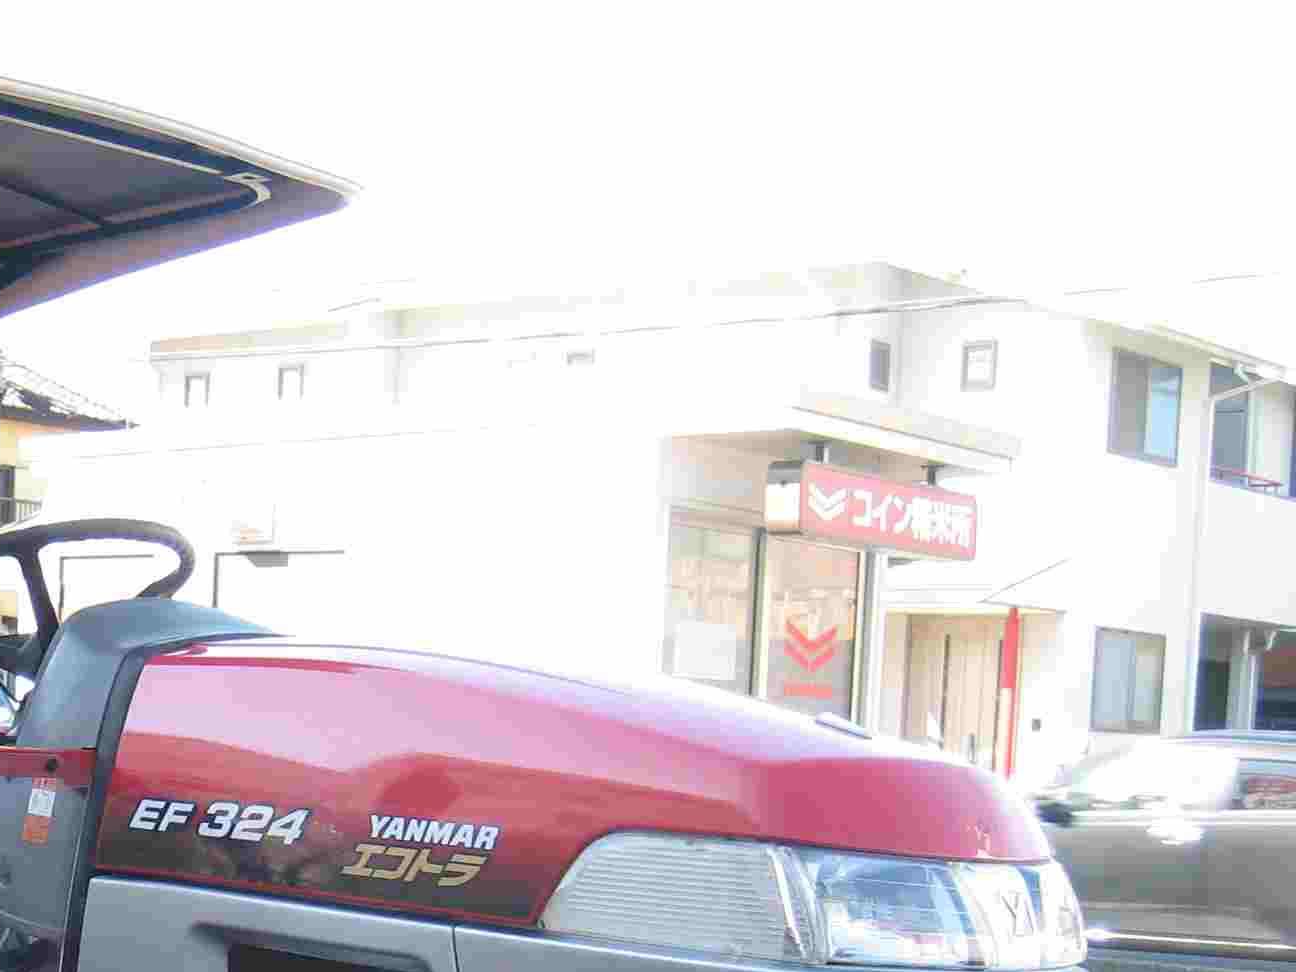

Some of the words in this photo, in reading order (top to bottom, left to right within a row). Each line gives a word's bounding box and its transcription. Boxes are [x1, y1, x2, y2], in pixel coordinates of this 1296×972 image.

[128, 798, 195, 832] EF
[197, 801, 309, 845] 324
[368, 814, 499, 849] YANMAR
[341, 843, 488, 887] エコトラ
